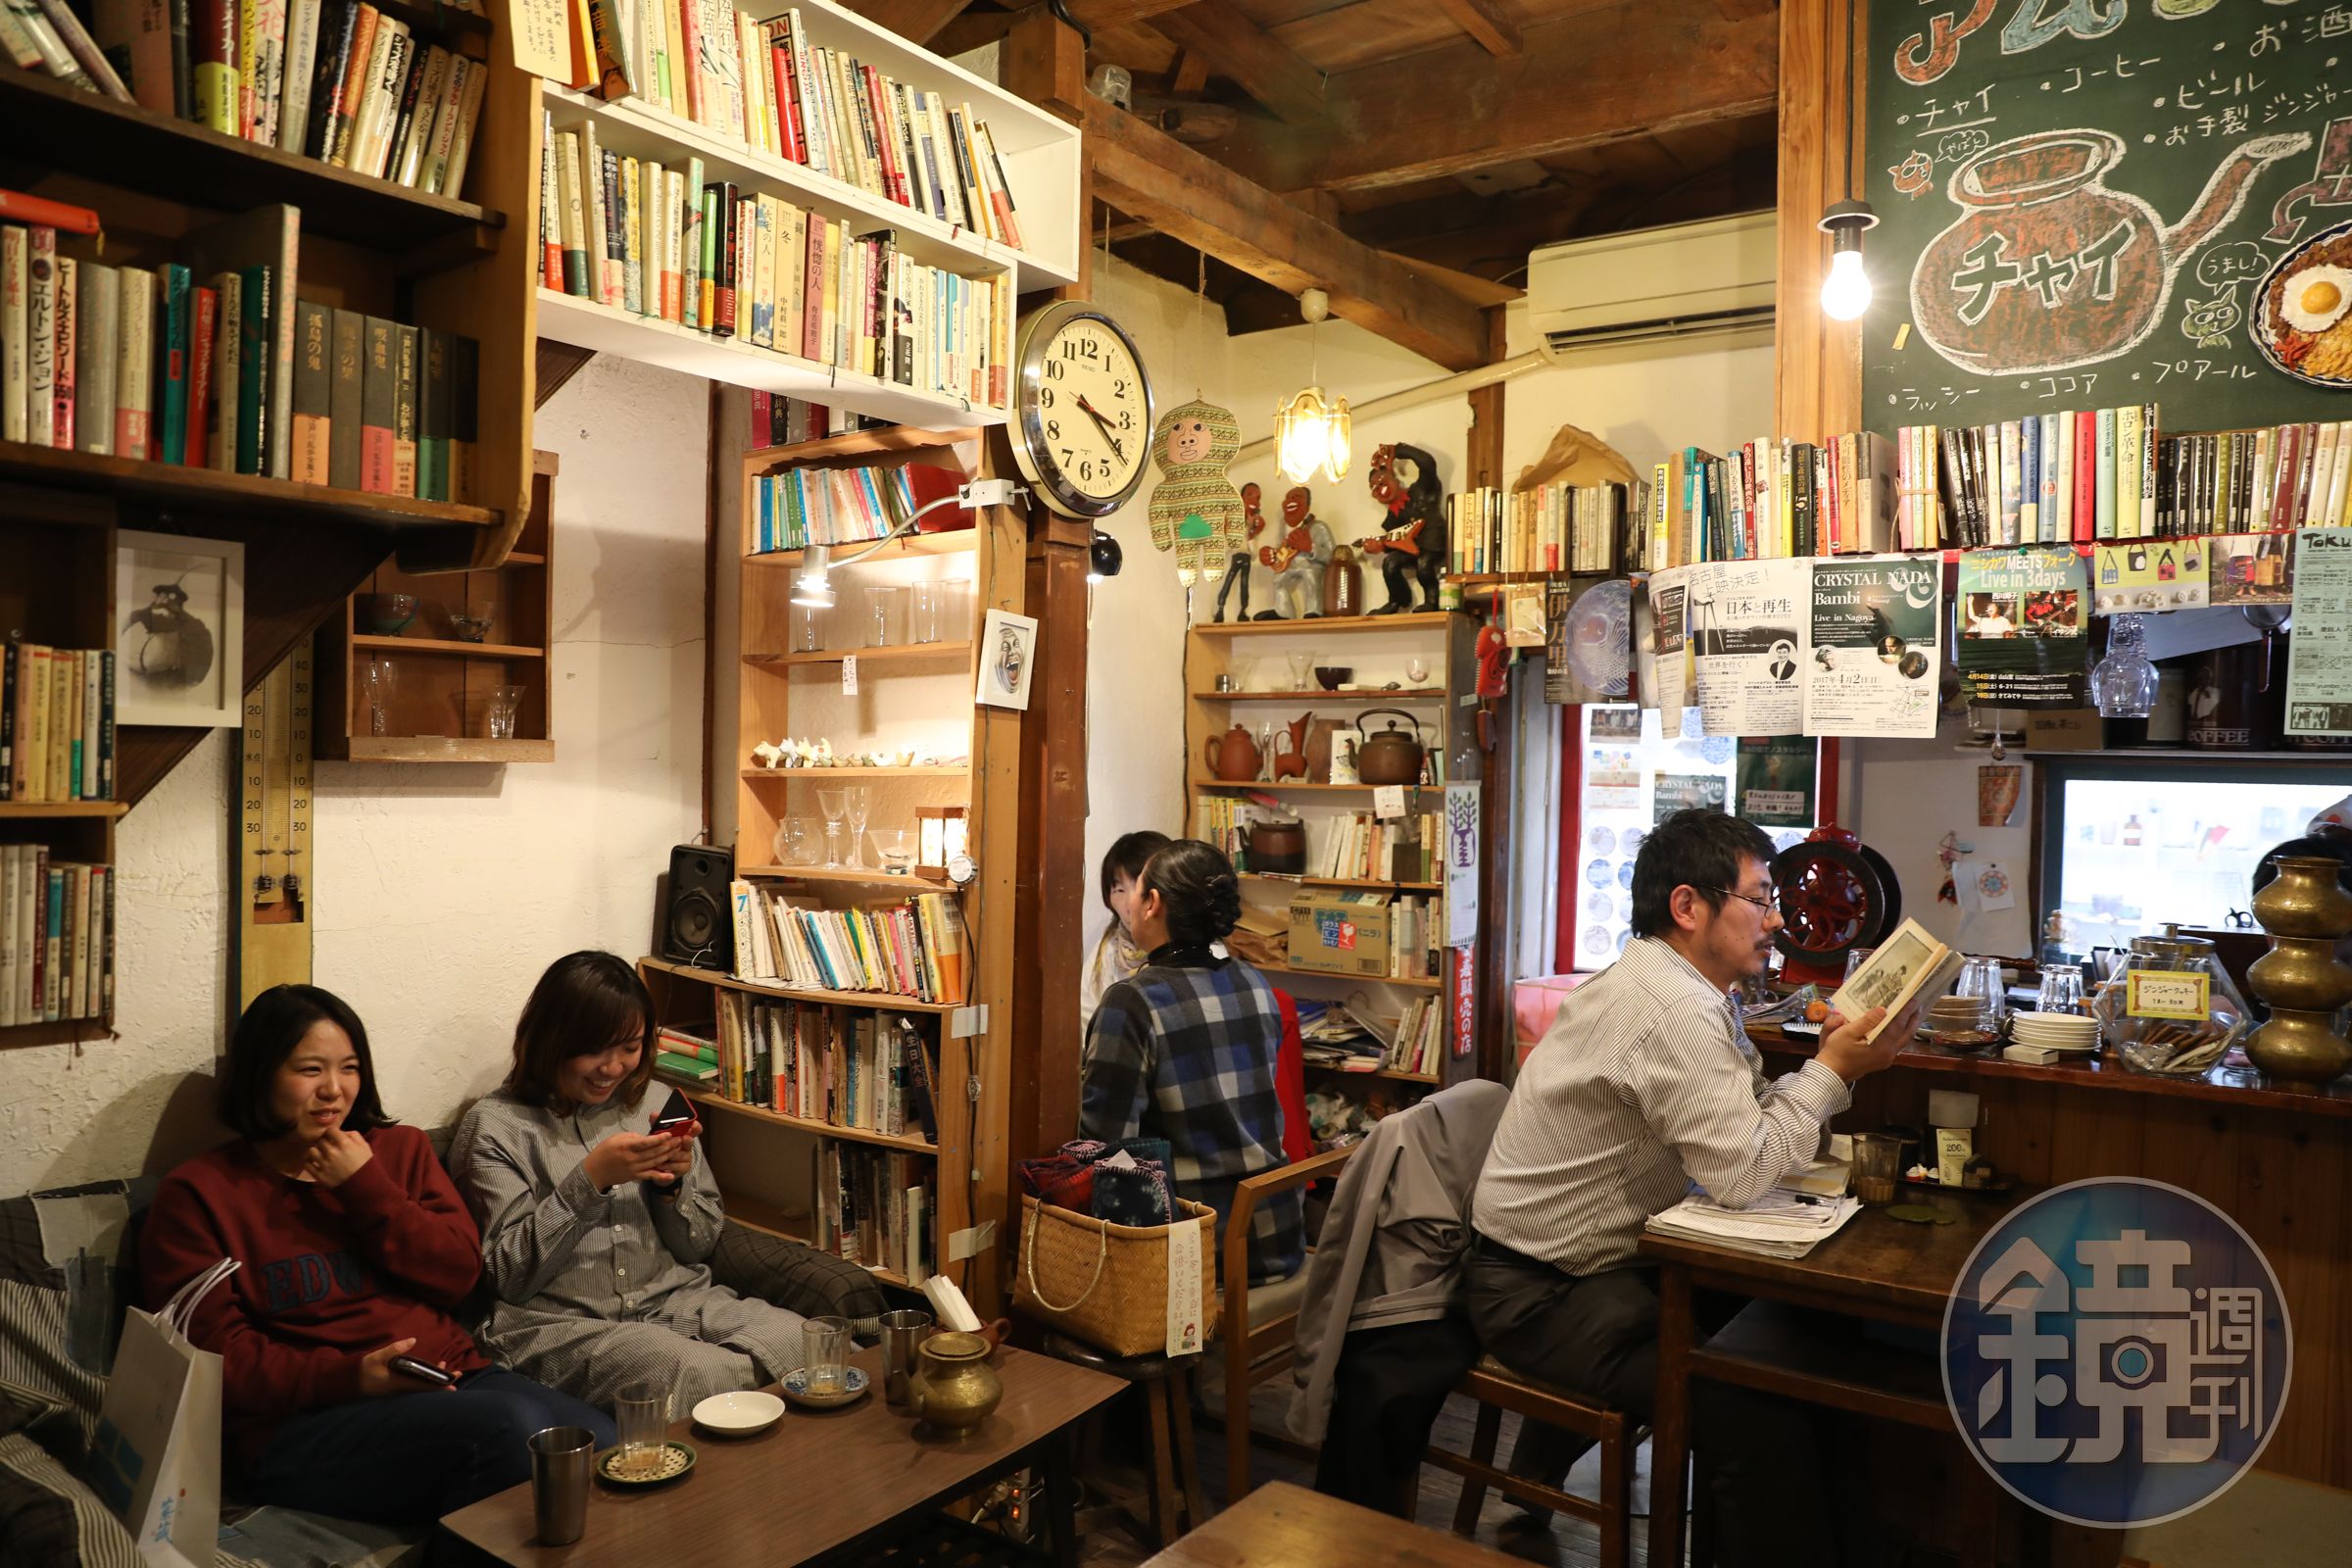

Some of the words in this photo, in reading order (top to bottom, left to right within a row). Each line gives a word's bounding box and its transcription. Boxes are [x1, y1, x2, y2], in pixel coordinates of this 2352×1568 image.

[2061, 54, 2161, 93] コーヒー
[2178, 70, 2267, 109] ビール
[1915, 83, 1996, 127] チャイ
[2164, 104, 2250, 146] お手製
[781, 229, 793, 244] 冬
[810, 237, 823, 291] 恍惚の人
[1953, 219, 2137, 327] チャイ
[30, 285, 53, 393] エルトン・ジョン
[307, 312, 322, 371] 孤島の鬼
[1062, 340, 1076, 361] 11
[1080, 338, 1099, 360] 12
[1046, 359, 1064, 381] 10
[1103, 355, 1111, 373] 1
[1114, 379, 1125, 399] 2
[2038, 373, 2098, 399] ココア
[1041, 387, 1054, 409] 9
[1901, 386, 1981, 413] ラッシー
[1047, 419, 1060, 441] 8
[1119, 411, 1131, 430] 3
[2121, 410, 2135, 463] ホロン革命
[1061, 448, 1074, 468] 7
[1080, 461, 1093, 482] 6
[1099, 458, 1110, 478] 5
[1971, 553, 2077, 571] ニシカワMEETSフォーク
[1689, 564, 1727, 587] 名古屋
[1814, 572, 1882, 587] CRYSTAL
[1886, 570, 1933, 585] NADA
[1981, 570, 2008, 589] Live
[2011, 570, 2024, 588] in
[2026, 570, 2067, 591] 3days
[1726, 598, 1792, 614] 日本と再生
[1814, 591, 1862, 606] Bambi
[1844, 613, 1874, 623] Nagoya
[295, 682, 308, 694] 30
[247, 705, 263, 716] 20
[295, 708, 309, 717] 20
[249, 729, 262, 739] 10
[294, 730, 307, 740] 10
[296, 754, 304, 762] 0
[248, 776, 262, 786] 10
[293, 776, 306, 786] 10
[246, 800, 262, 809] 20
[293, 799, 307, 809] 20
[246, 822, 262, 833] 30
[293, 821, 307, 832] 30
[736, 894, 748, 912] 7
[2143, 984, 2195, 995] ジンジャークッキー
